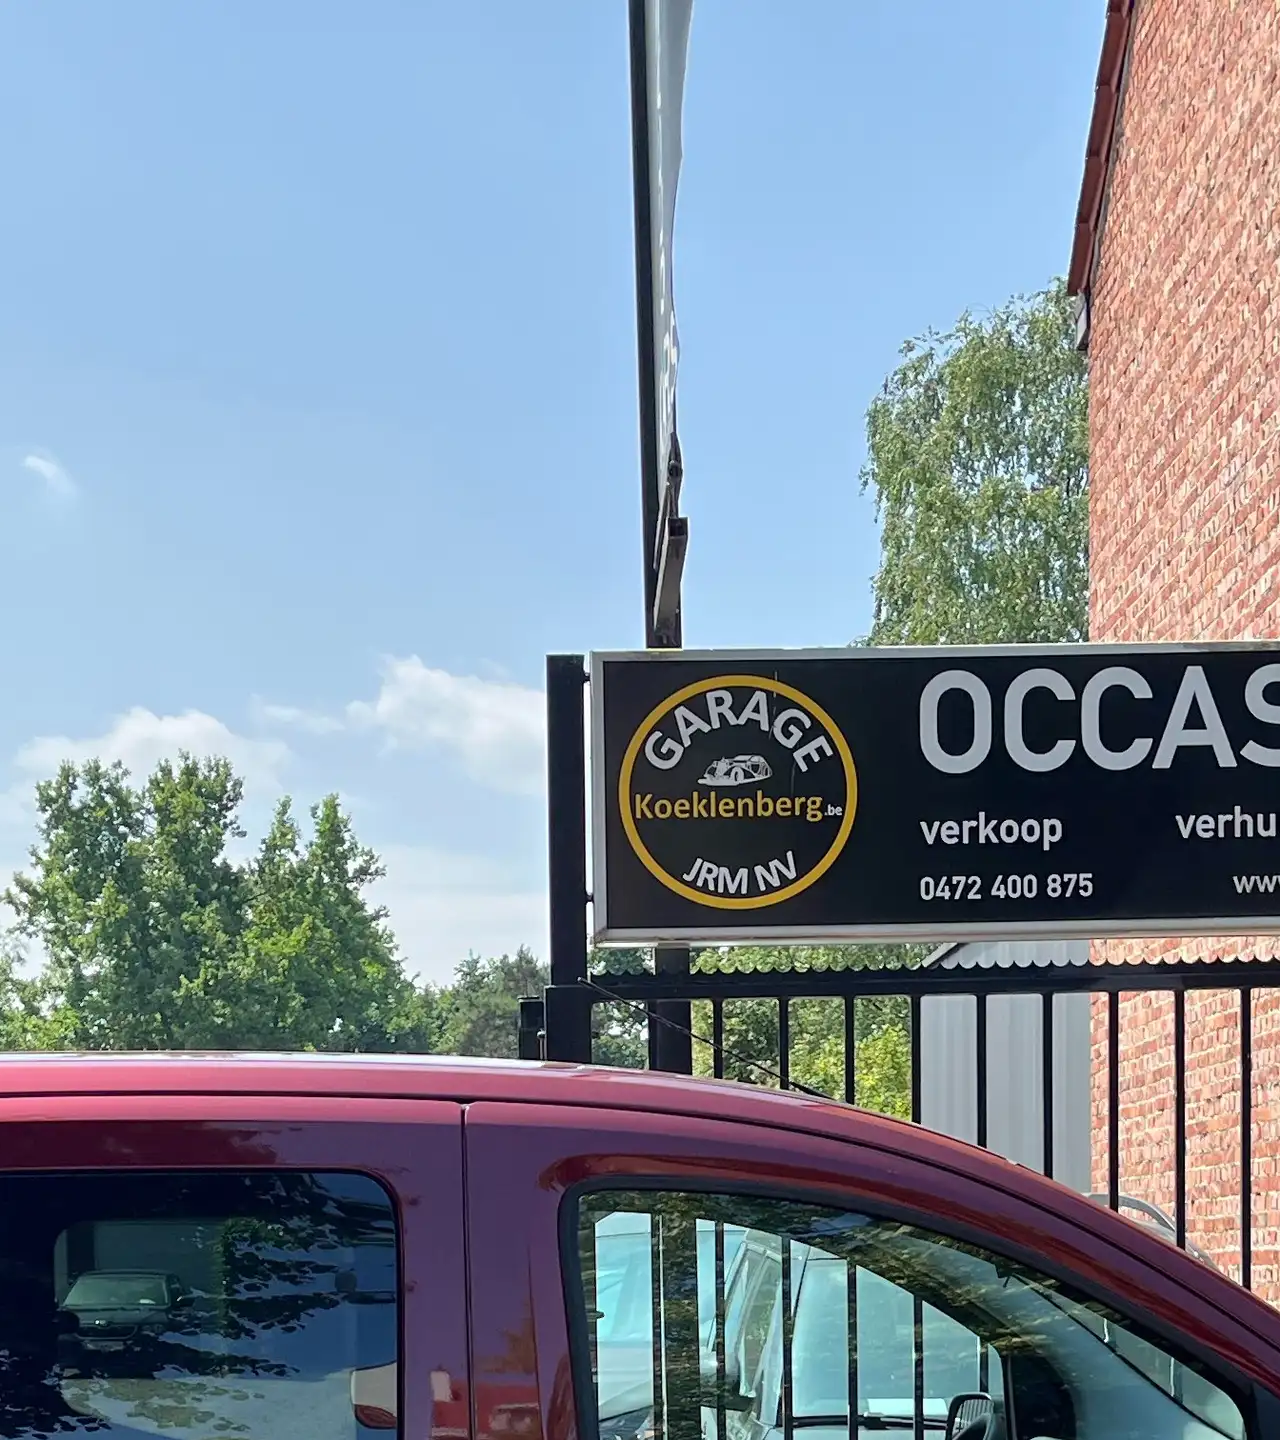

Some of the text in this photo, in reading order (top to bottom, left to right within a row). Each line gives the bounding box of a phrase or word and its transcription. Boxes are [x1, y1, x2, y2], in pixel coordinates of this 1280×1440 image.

[643, 688, 835, 773] GARAGE
[919, 811, 1063, 851] verkoop
[682, 850, 798, 895] JRM NV
[919, 872, 1094, 901] 0472 400 875
